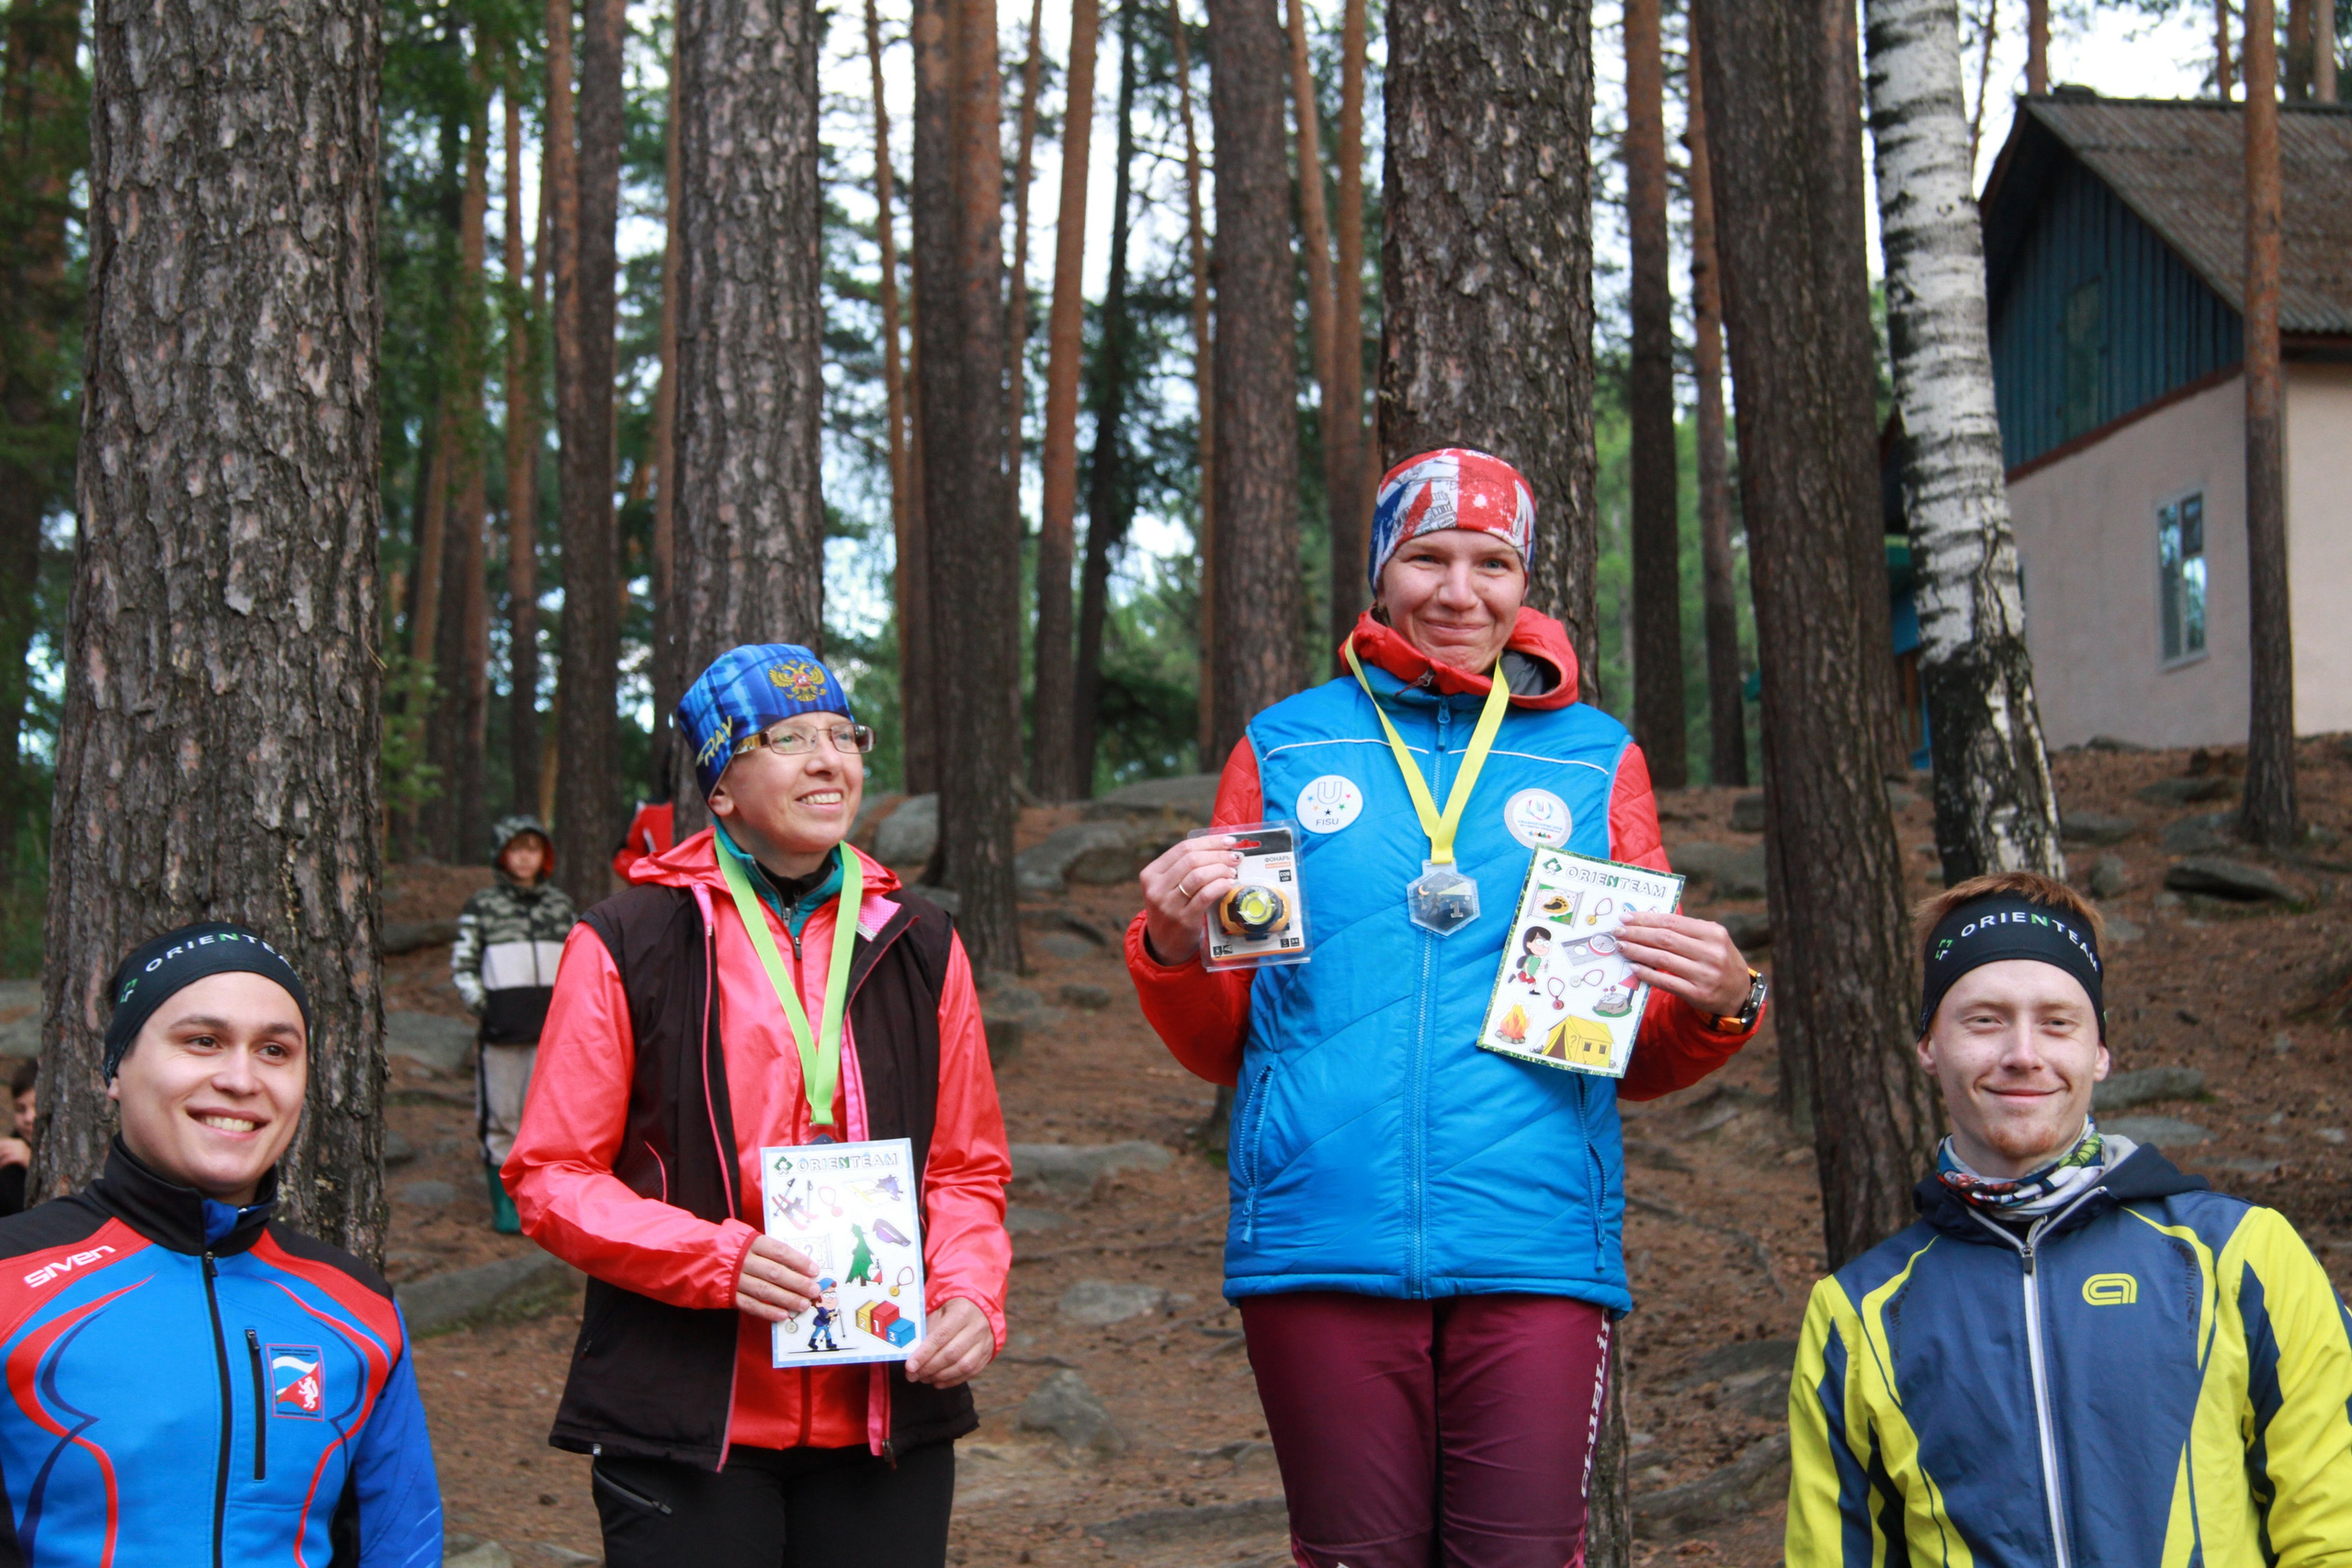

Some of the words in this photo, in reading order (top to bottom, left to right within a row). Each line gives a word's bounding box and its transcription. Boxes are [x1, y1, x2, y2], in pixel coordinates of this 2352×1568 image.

[1316, 818, 1340, 827] FISU
[1566, 866, 1668, 898] ORIENTEAM
[797, 1153, 898, 1172] ORIENTEAM
